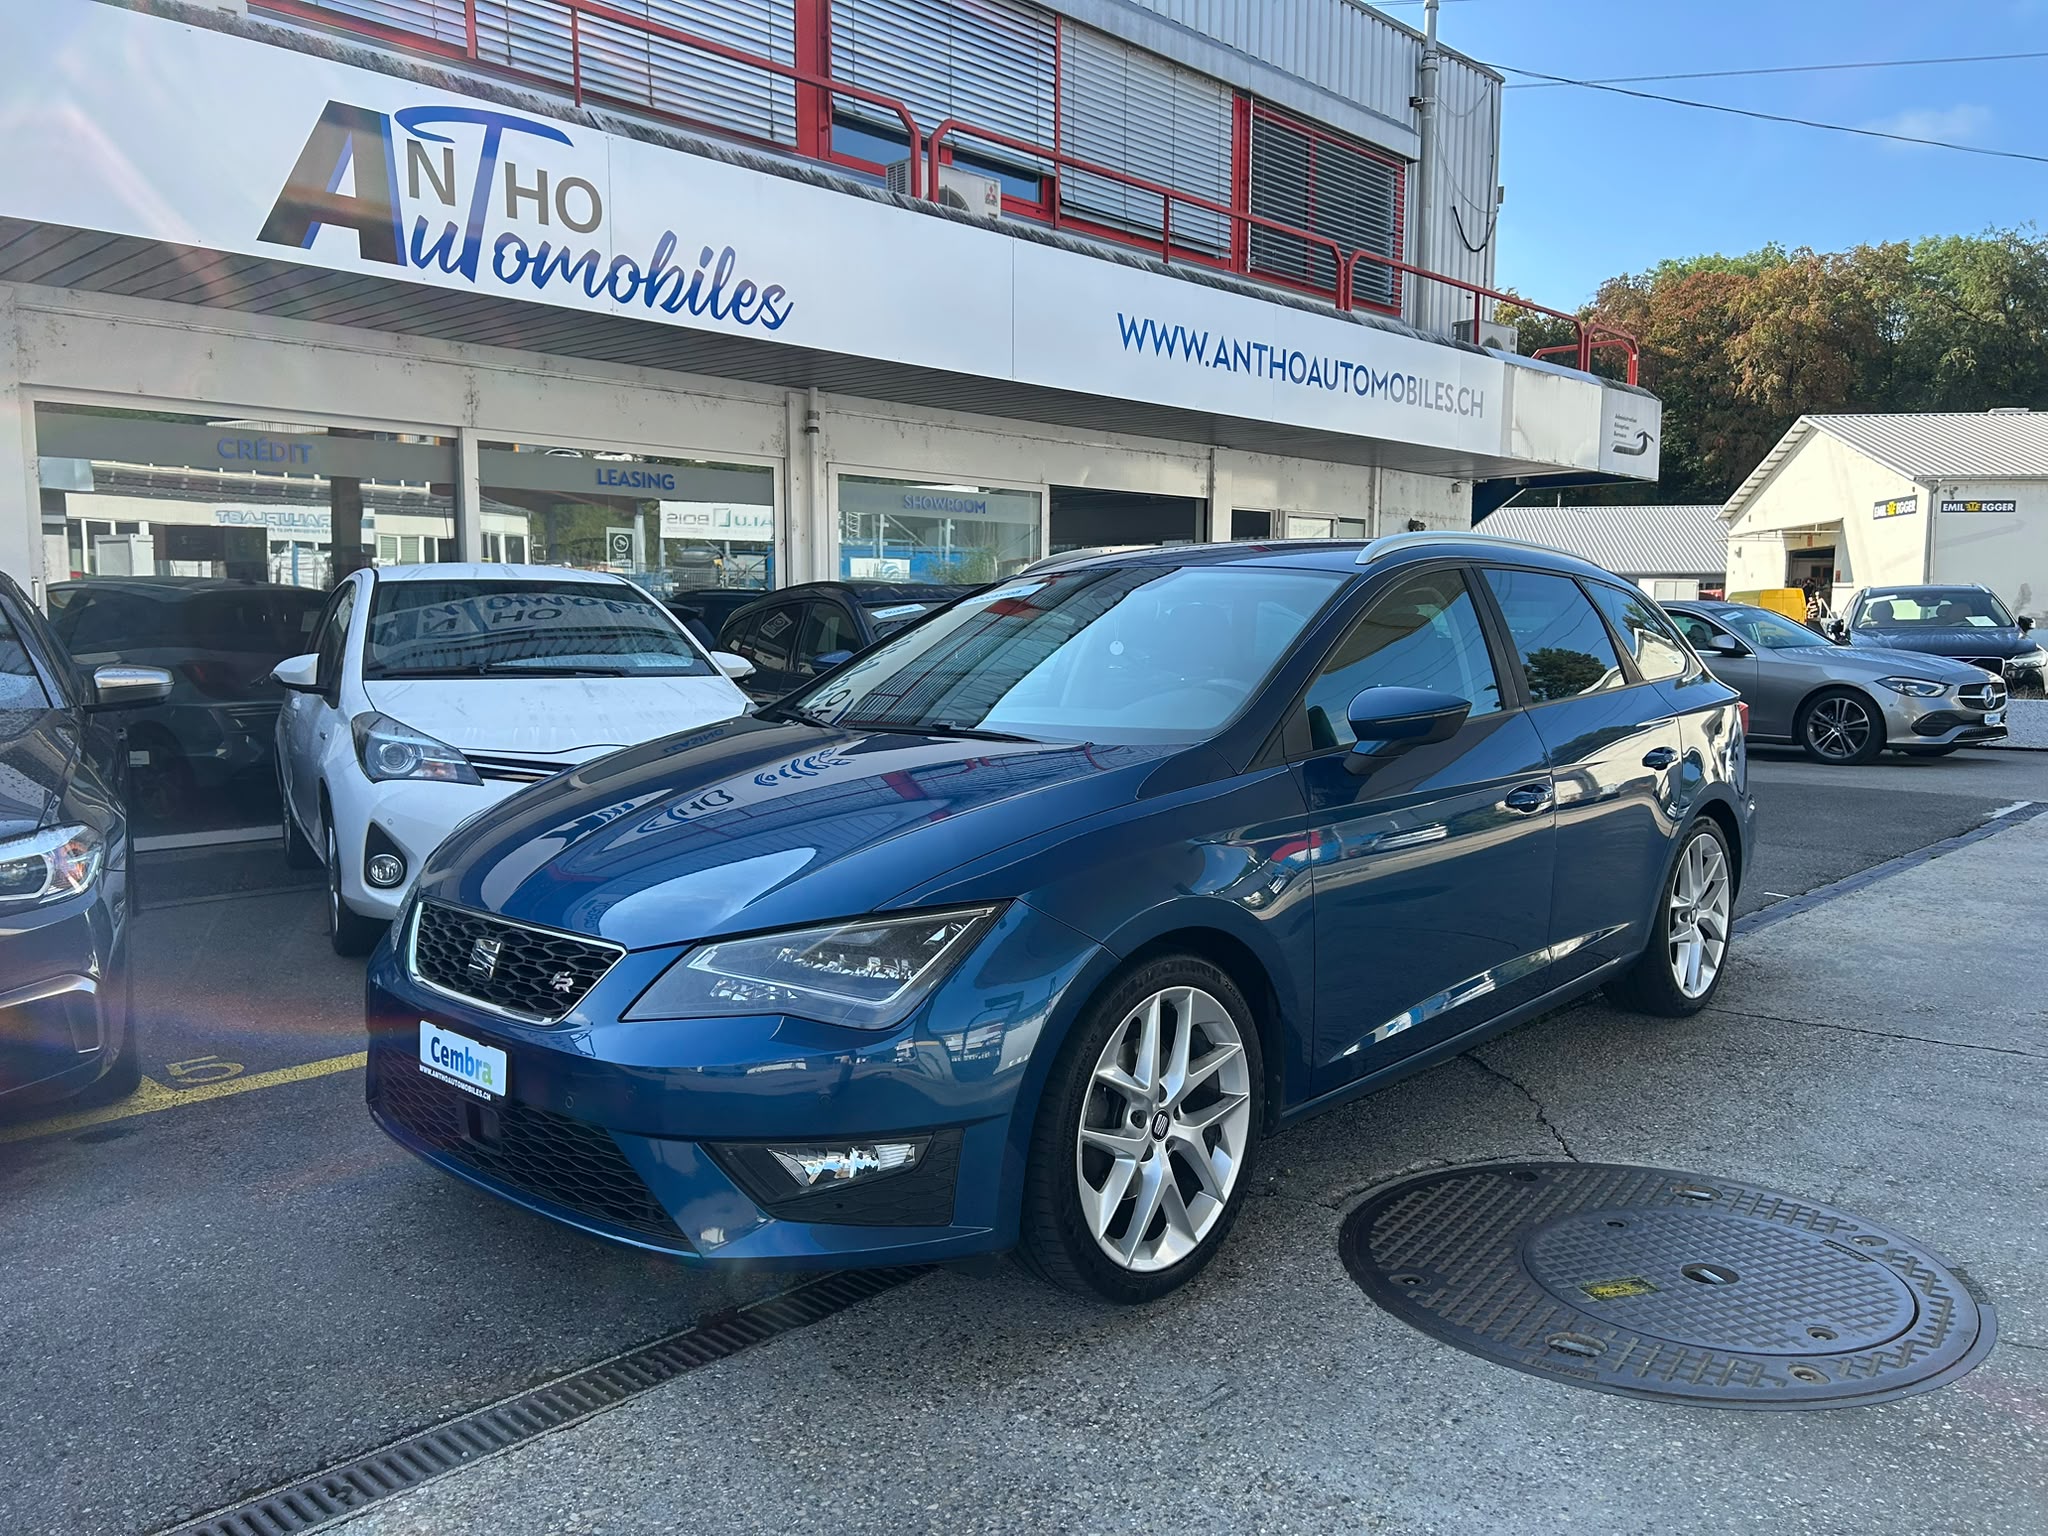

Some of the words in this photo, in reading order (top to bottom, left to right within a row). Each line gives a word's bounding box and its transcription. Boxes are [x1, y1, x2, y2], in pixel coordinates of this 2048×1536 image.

[1117, 312, 1484, 419] WWW.ANTHOAUTOMOBILES.CH
[217, 437, 312, 464] CRÉDIT
[596, 467, 675, 491] LEASING
[903, 493, 987, 516] SHOWROOM
[1874, 505, 1887, 518] EMIL
[1896, 500, 1916, 515] EGGER
[1943, 503, 1965, 512] EMIL
[1981, 503, 2014, 512] EGGER
[165, 1055, 245, 1083] 5
[431, 1036, 493, 1086] Cembra
